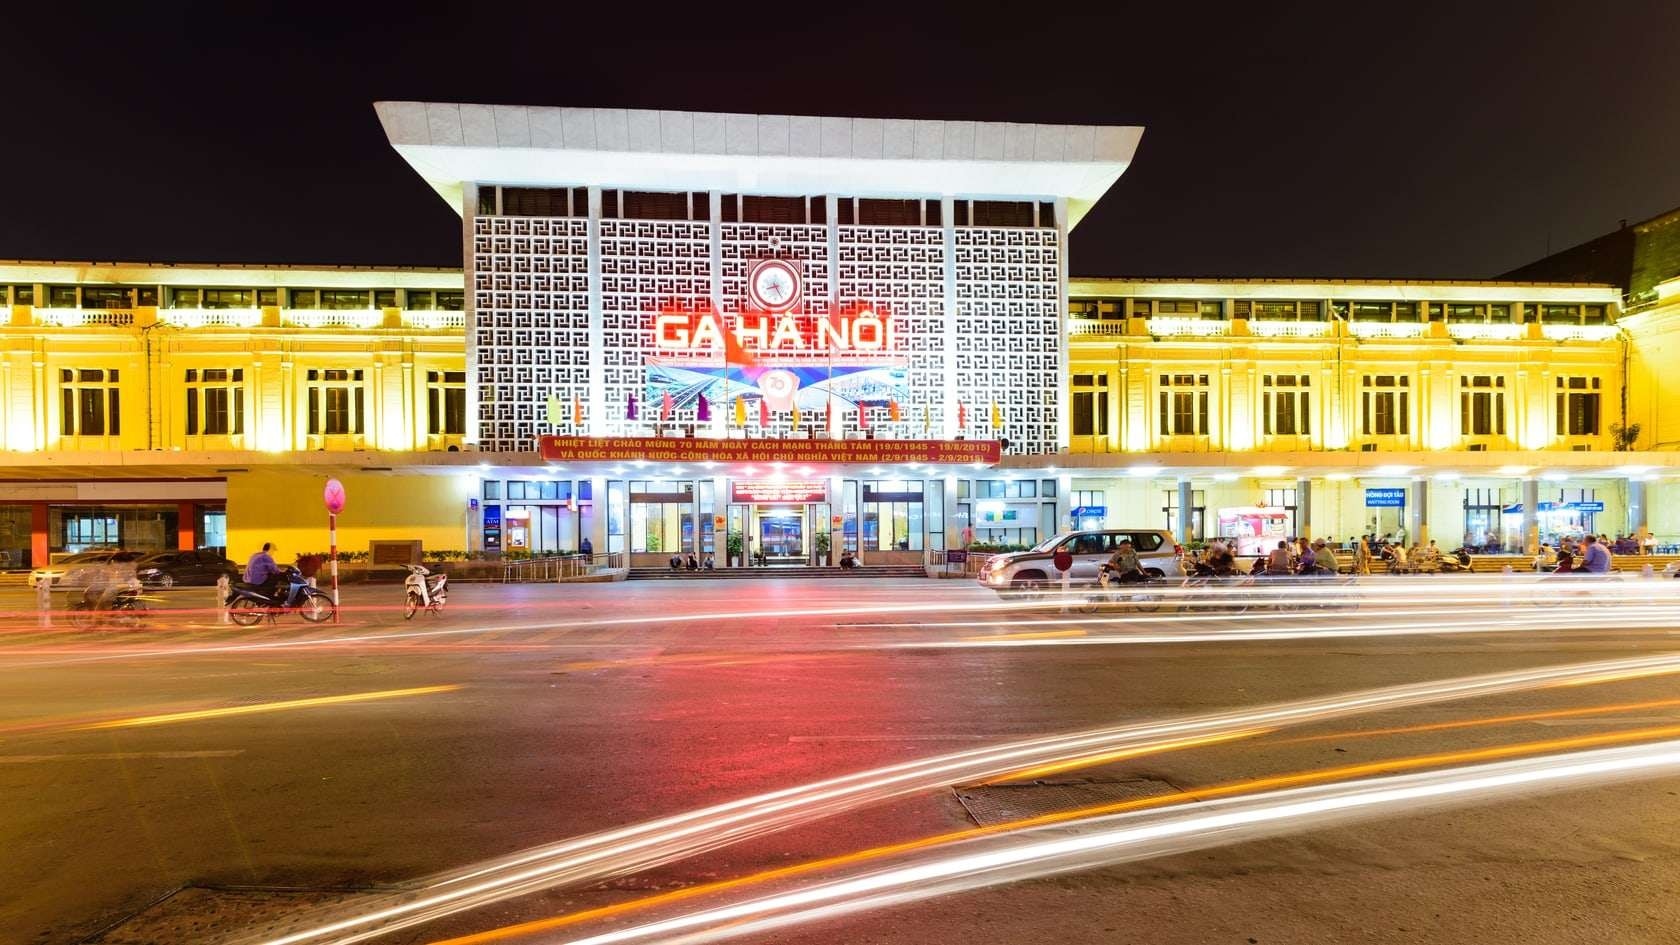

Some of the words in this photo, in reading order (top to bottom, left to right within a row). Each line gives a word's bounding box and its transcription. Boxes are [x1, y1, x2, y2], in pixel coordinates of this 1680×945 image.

[656, 314, 726, 348] GA
[734, 311, 805, 349] HÀ
[554, 438, 584, 448] NHIỆT
[588, 438, 609, 448] LIỆT
[613, 439, 642, 448] CHÀO
[680, 441, 692, 449] 70
[751, 441, 779, 449] CÁCH
[815, 441, 848, 450] THÁNG
[851, 441, 872, 450] TÁM
[876, 442, 928, 451] (19/8/1945
[939, 443, 991, 453] 19/8/2015)
[577, 450, 608, 459] QUỐC
[610, 450, 645, 459] KHÁNH
[831, 452, 853, 462] VIỆT
[855, 453, 878, 461] NAM
[882, 453, 928, 462] (2/9/1945
